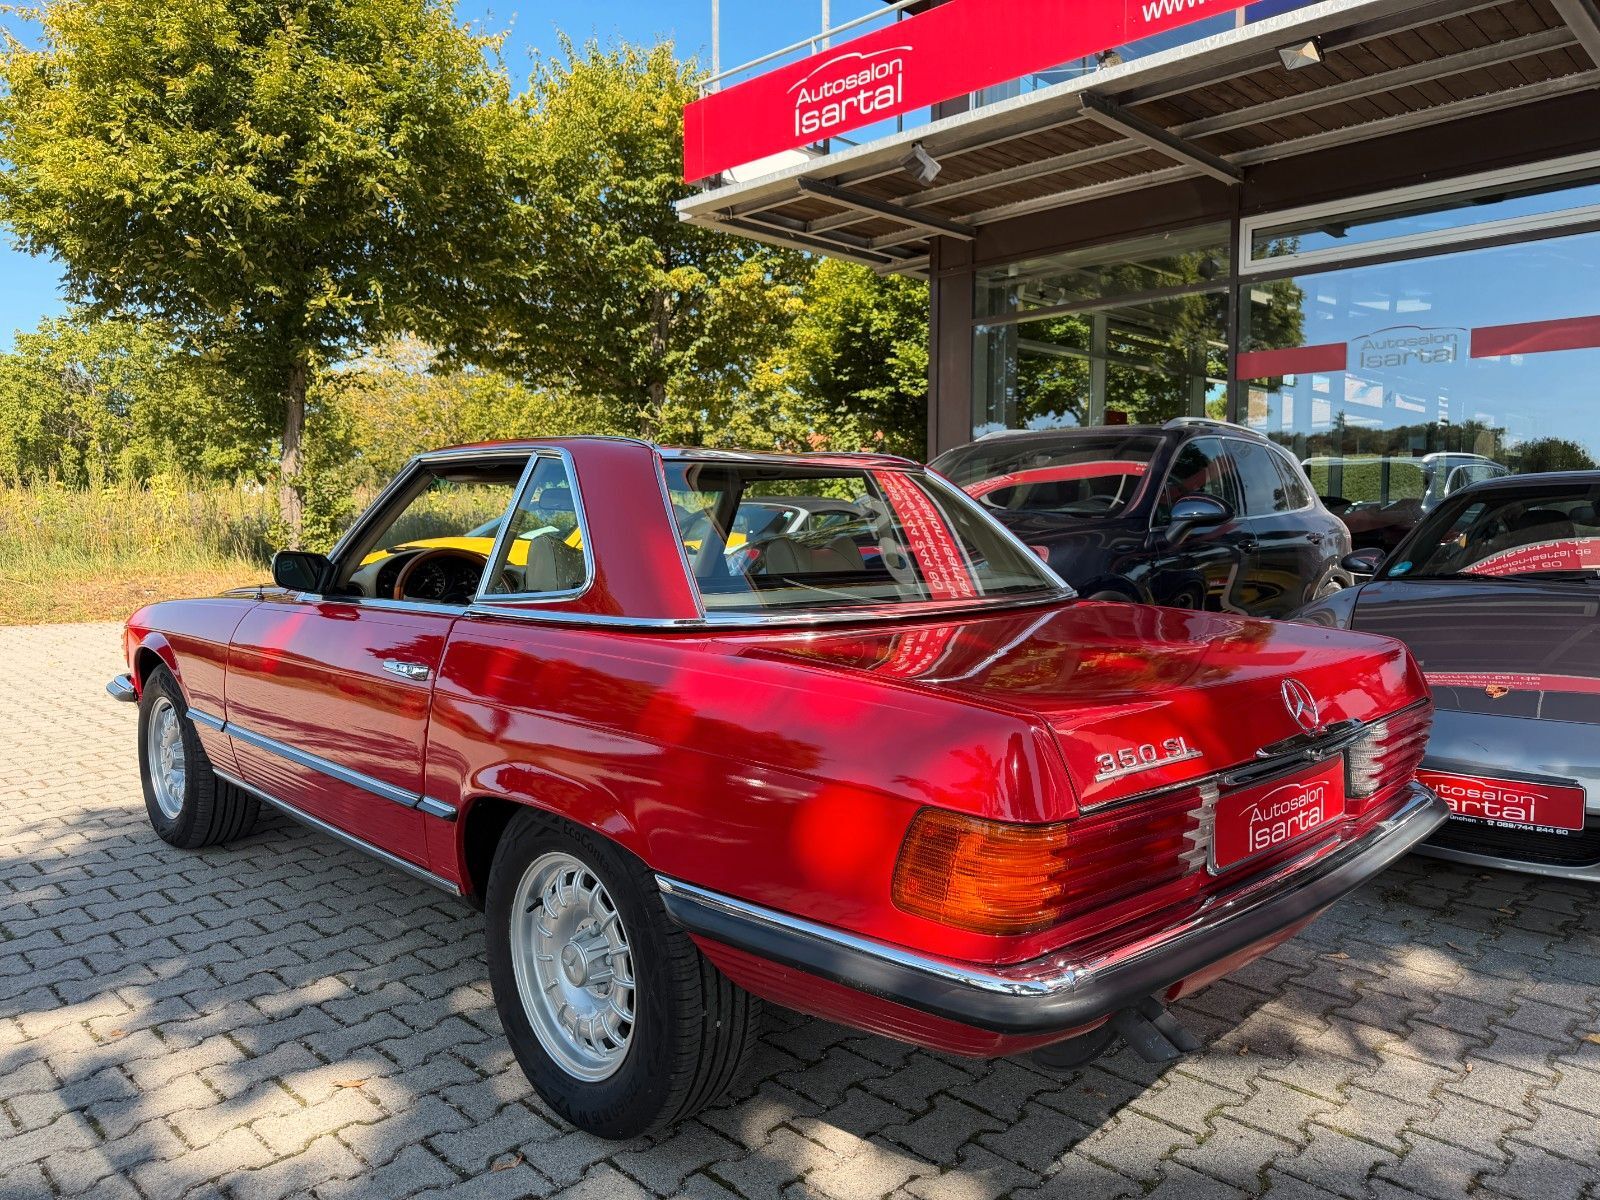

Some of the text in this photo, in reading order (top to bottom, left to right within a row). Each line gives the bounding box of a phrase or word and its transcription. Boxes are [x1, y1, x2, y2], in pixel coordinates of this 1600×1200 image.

[795, 58, 902, 108] Autosalon
[795, 72, 902, 137] Isartal
[1361, 343, 1457, 368] Isartal
[1362, 333, 1458, 350] Autosalon
[1095, 736, 1201, 773] 350 SL
[1249, 798, 1323, 852] Isartal
[1250, 787, 1323, 826] Autosalon
[1441, 796, 1535, 822] artal
